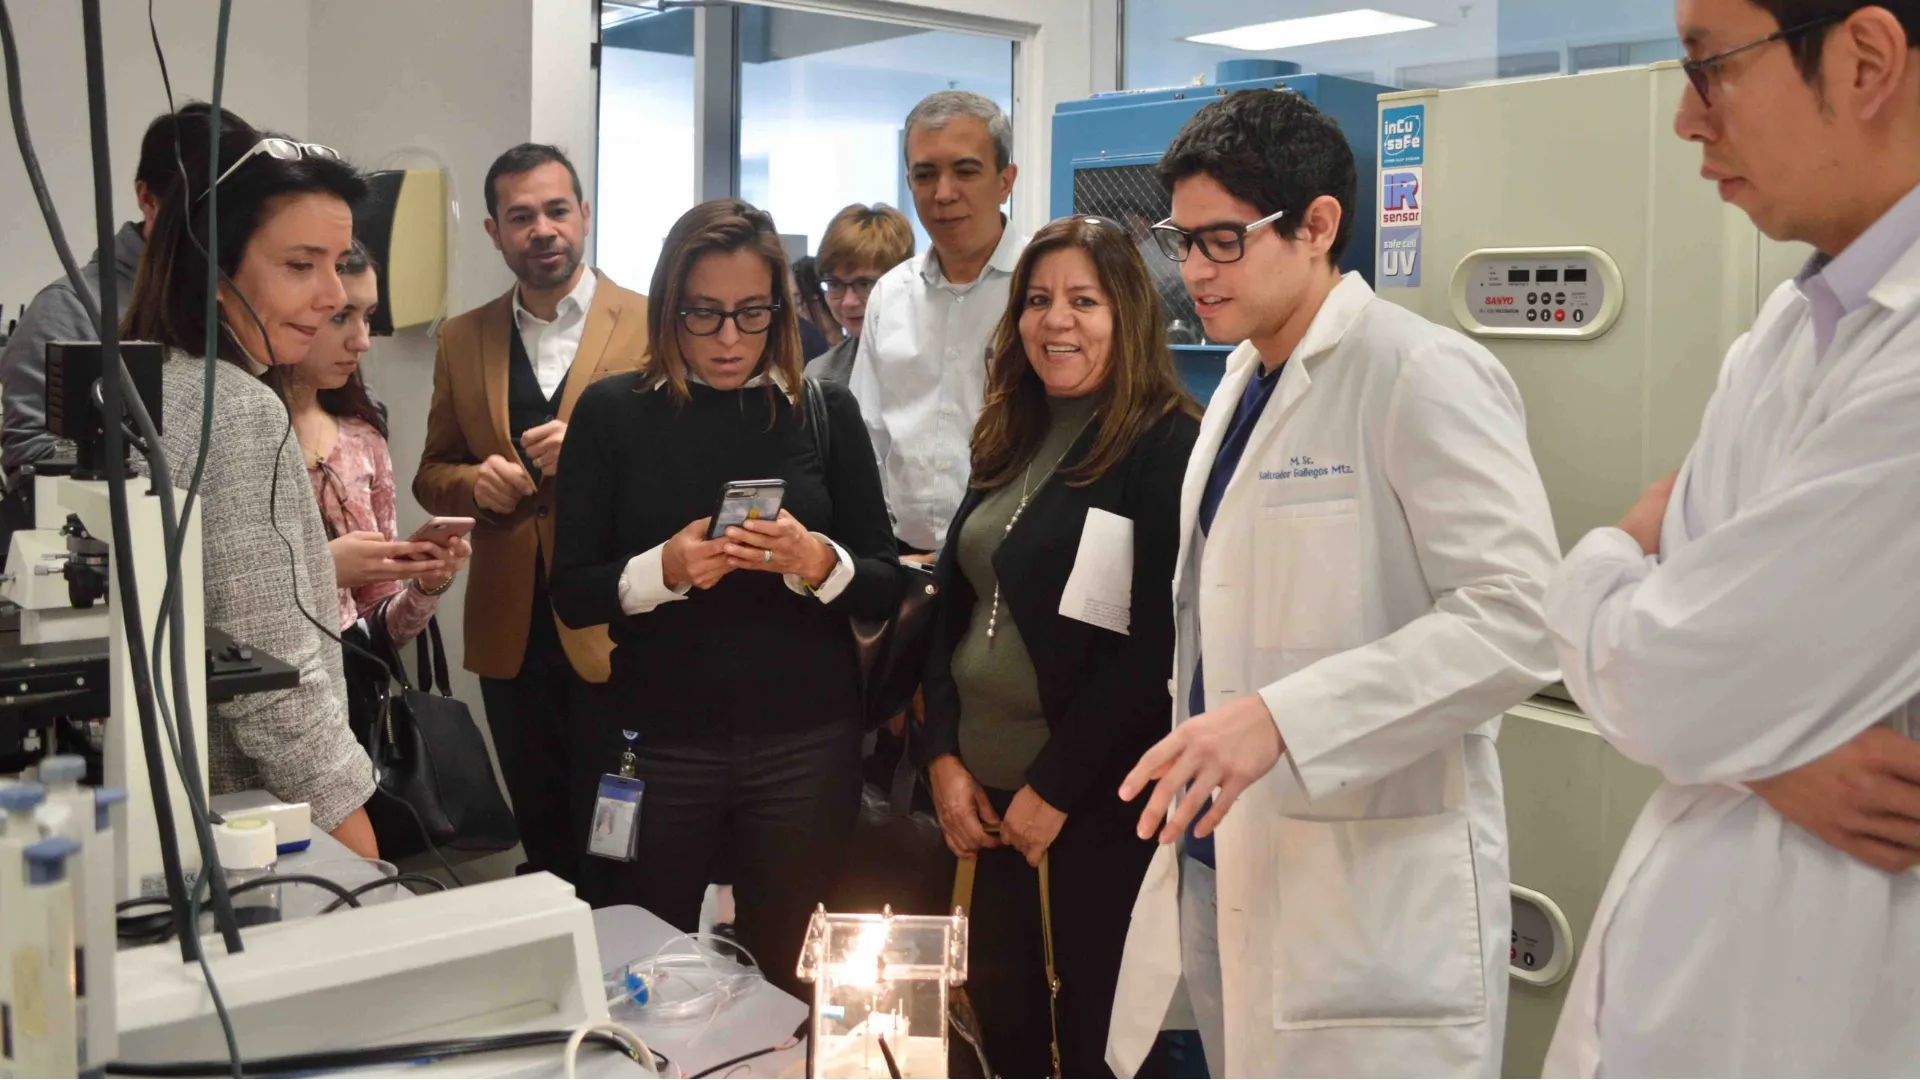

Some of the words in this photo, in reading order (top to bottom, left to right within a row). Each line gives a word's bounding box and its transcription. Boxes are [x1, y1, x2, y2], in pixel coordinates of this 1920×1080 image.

[1384, 172, 1419, 211] IR
[1383, 212, 1420, 223] sensor
[1383, 239, 1401, 249] safe
[1402, 239, 1417, 248] cell
[1383, 250, 1418, 277] UV
[1485, 297, 1514, 305] SANYO
[1302, 456, 1314, 465] Sc.
[1258, 470, 1291, 481] Salvador
[1293, 467, 1329, 479] Gallegos
